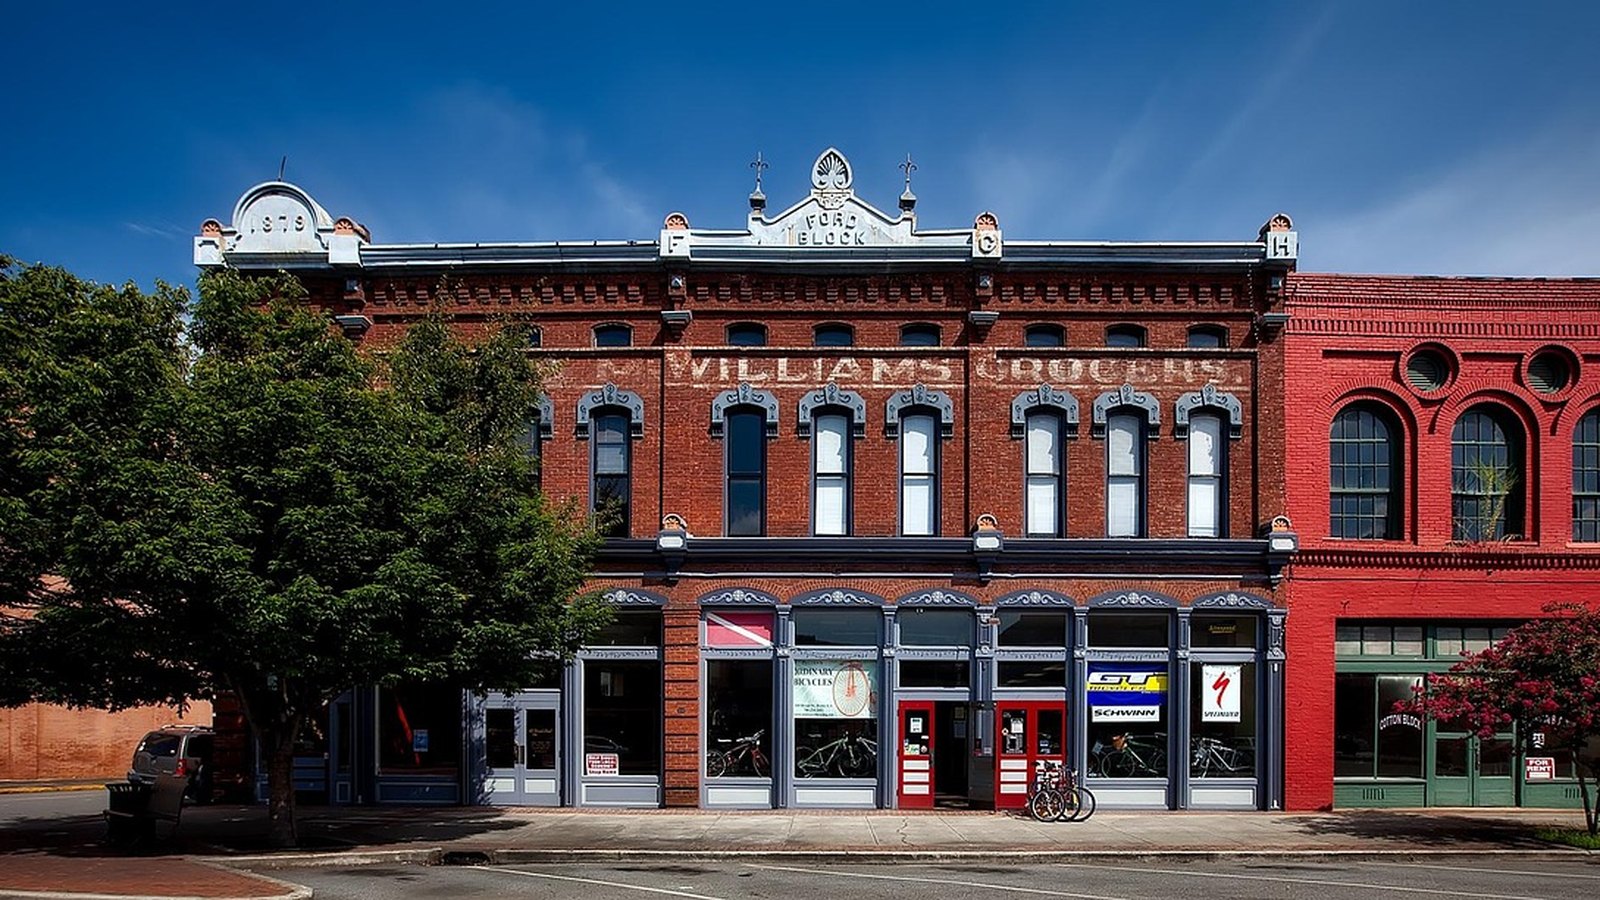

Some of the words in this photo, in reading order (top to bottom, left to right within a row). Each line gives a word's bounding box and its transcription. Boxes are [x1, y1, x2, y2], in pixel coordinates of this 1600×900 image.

[806, 213, 857, 230] FORD
[668, 235, 684, 254] F
[798, 232, 865, 245] BLOCK
[1273, 236, 1290, 257] H
[664, 353, 952, 381] WILLIAMS
[1094, 709, 1156, 717] SCHWINN
[1380, 714, 1402, 730] COTTON
[1403, 714, 1421, 730] BLOCK
